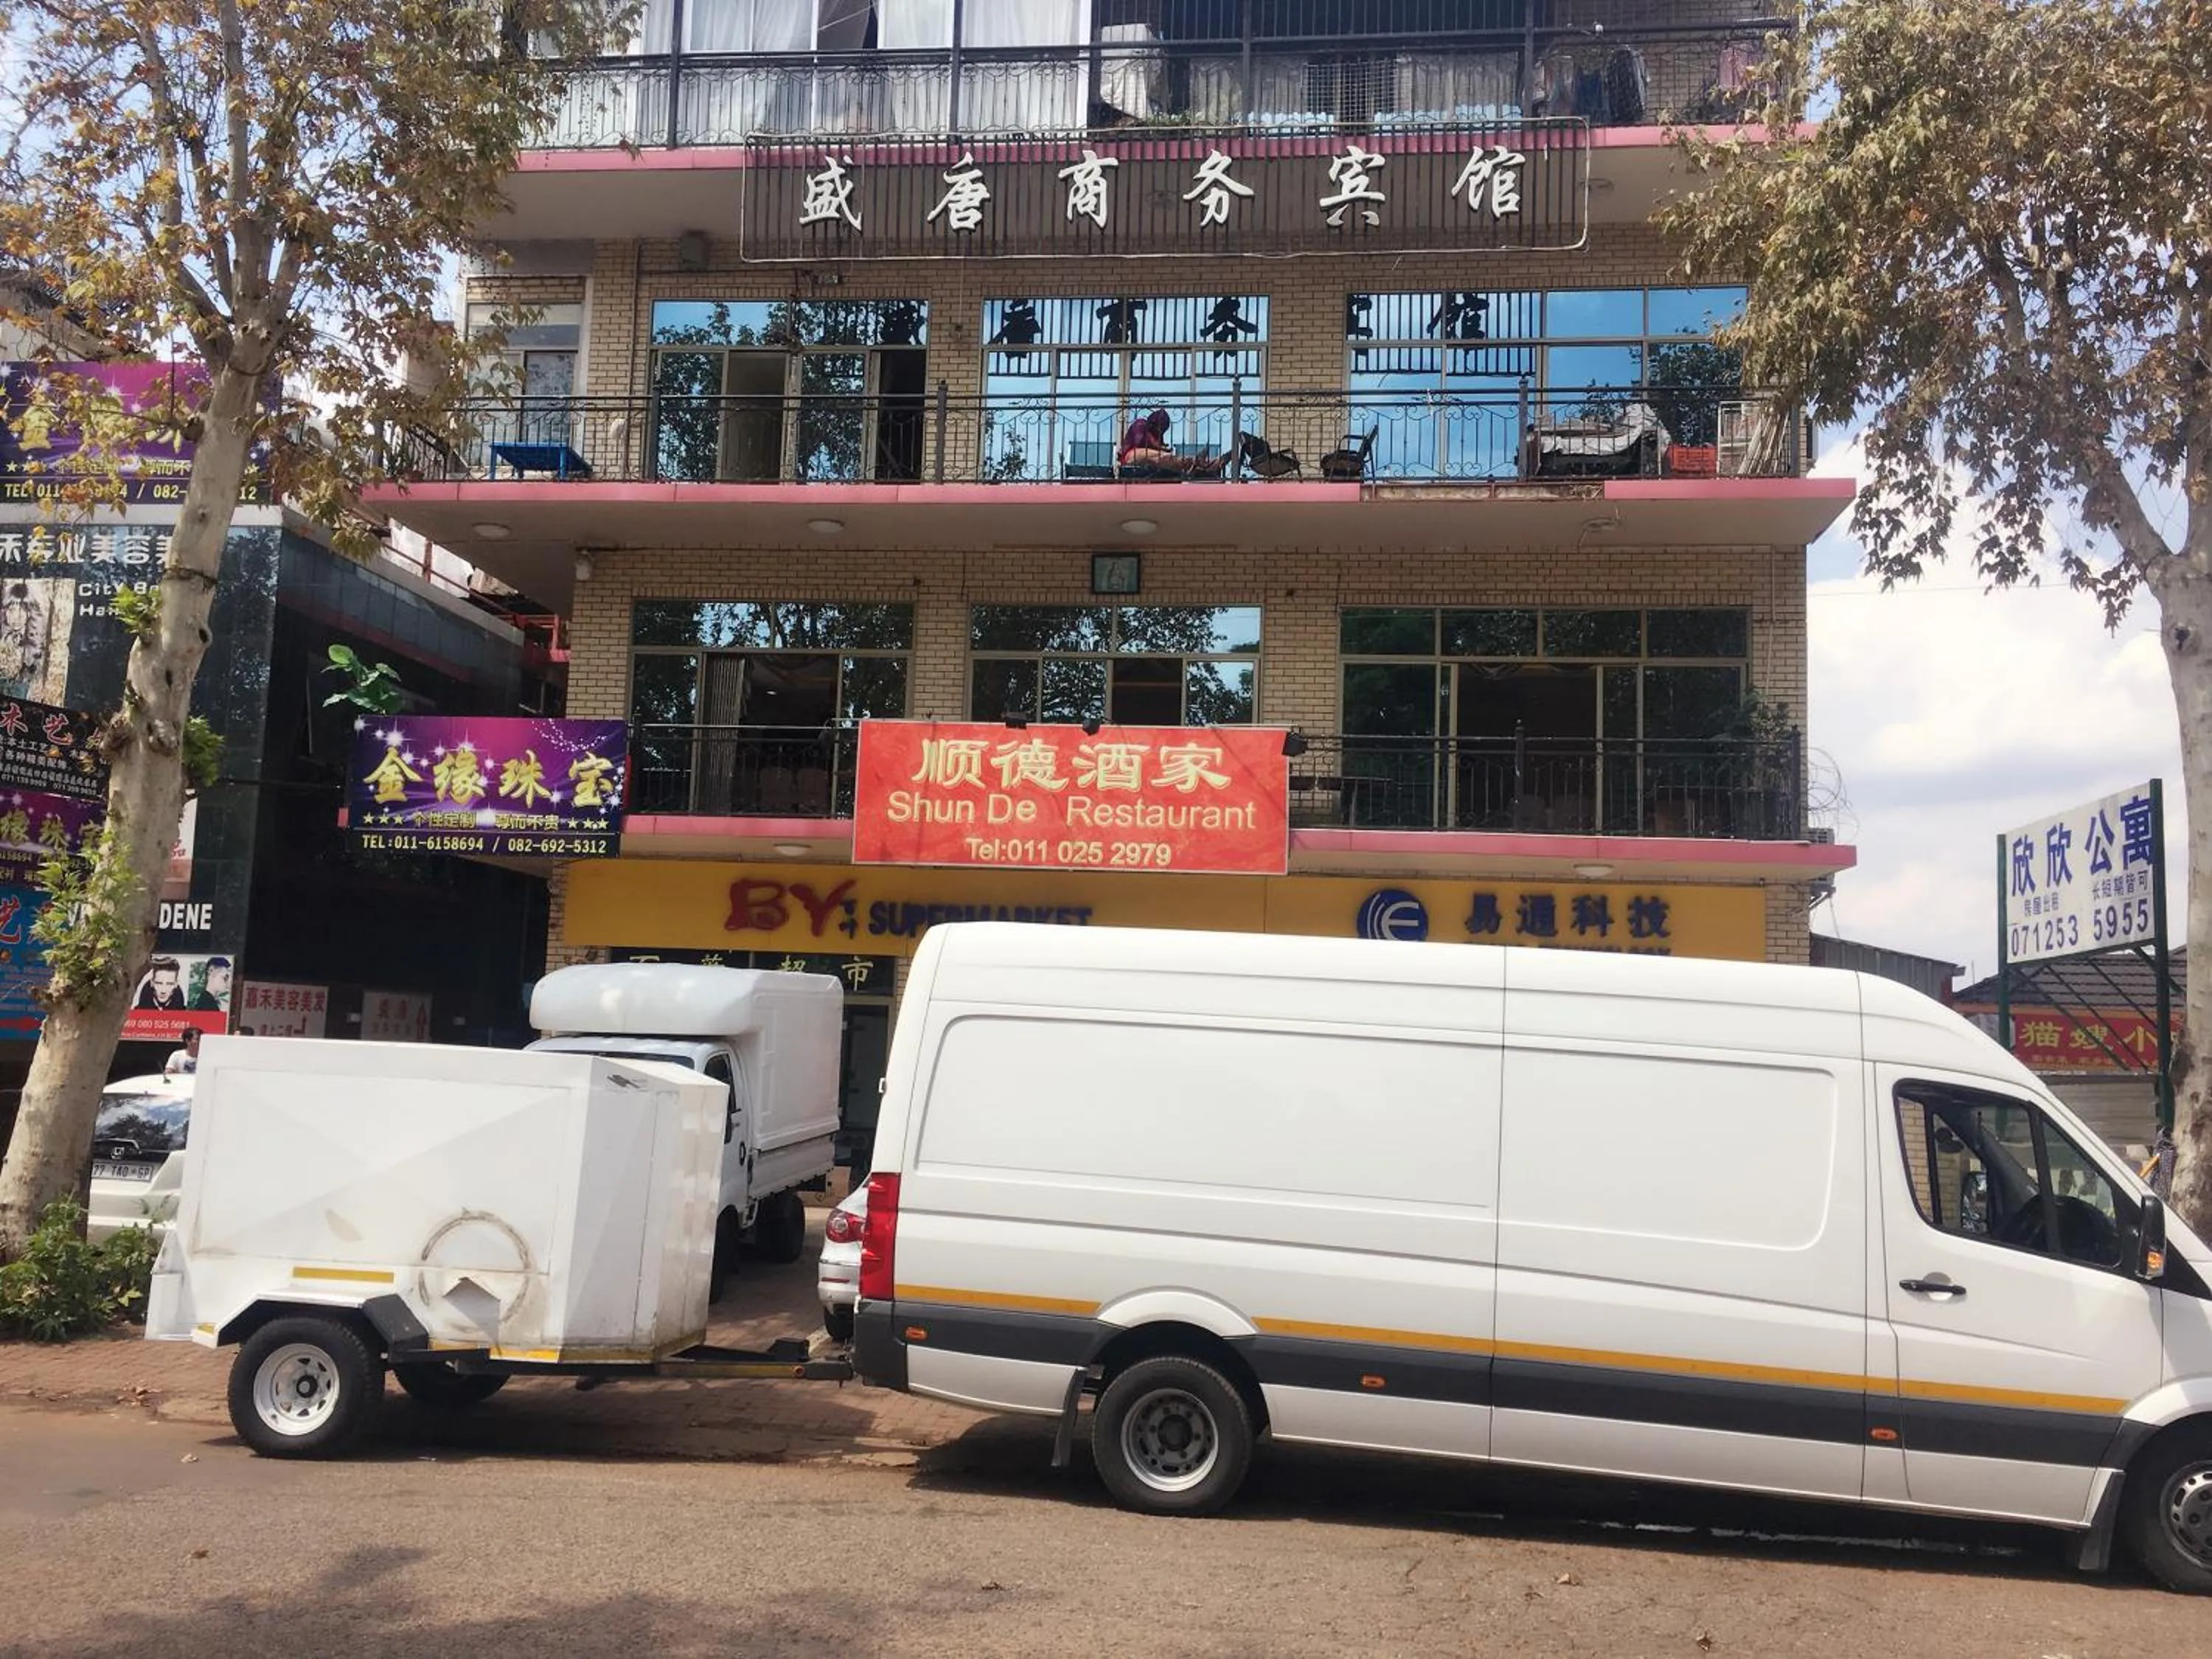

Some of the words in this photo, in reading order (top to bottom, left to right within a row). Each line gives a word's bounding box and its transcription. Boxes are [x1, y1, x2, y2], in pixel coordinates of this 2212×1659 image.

[799, 146, 1527, 232] 盛唐商务宾馆
[363, 746, 614, 808] 金缘珠宝
[910, 737, 1232, 793] 顺德酒家
[412, 811, 477, 828] 个性定制
[495, 813, 560, 830] 尊而不贵
[887, 790, 975, 824] Shun
[987, 793, 1037, 824] De
[1066, 795, 1256, 830] Restaurant
[362, 834, 484, 851] TEL:011-6158694
[508, 838, 607, 854] 082-692-5312
[966, 837, 1048, 862] Tel:011
[1057, 841, 1104, 863] 025
[1110, 842, 1172, 866] 2979
[2011, 796, 2153, 897] 欣欣公寓
[1464, 893, 1671, 939] 易通科技
[2011, 914, 2079, 956] 071253
[2093, 897, 2149, 941] 5955
